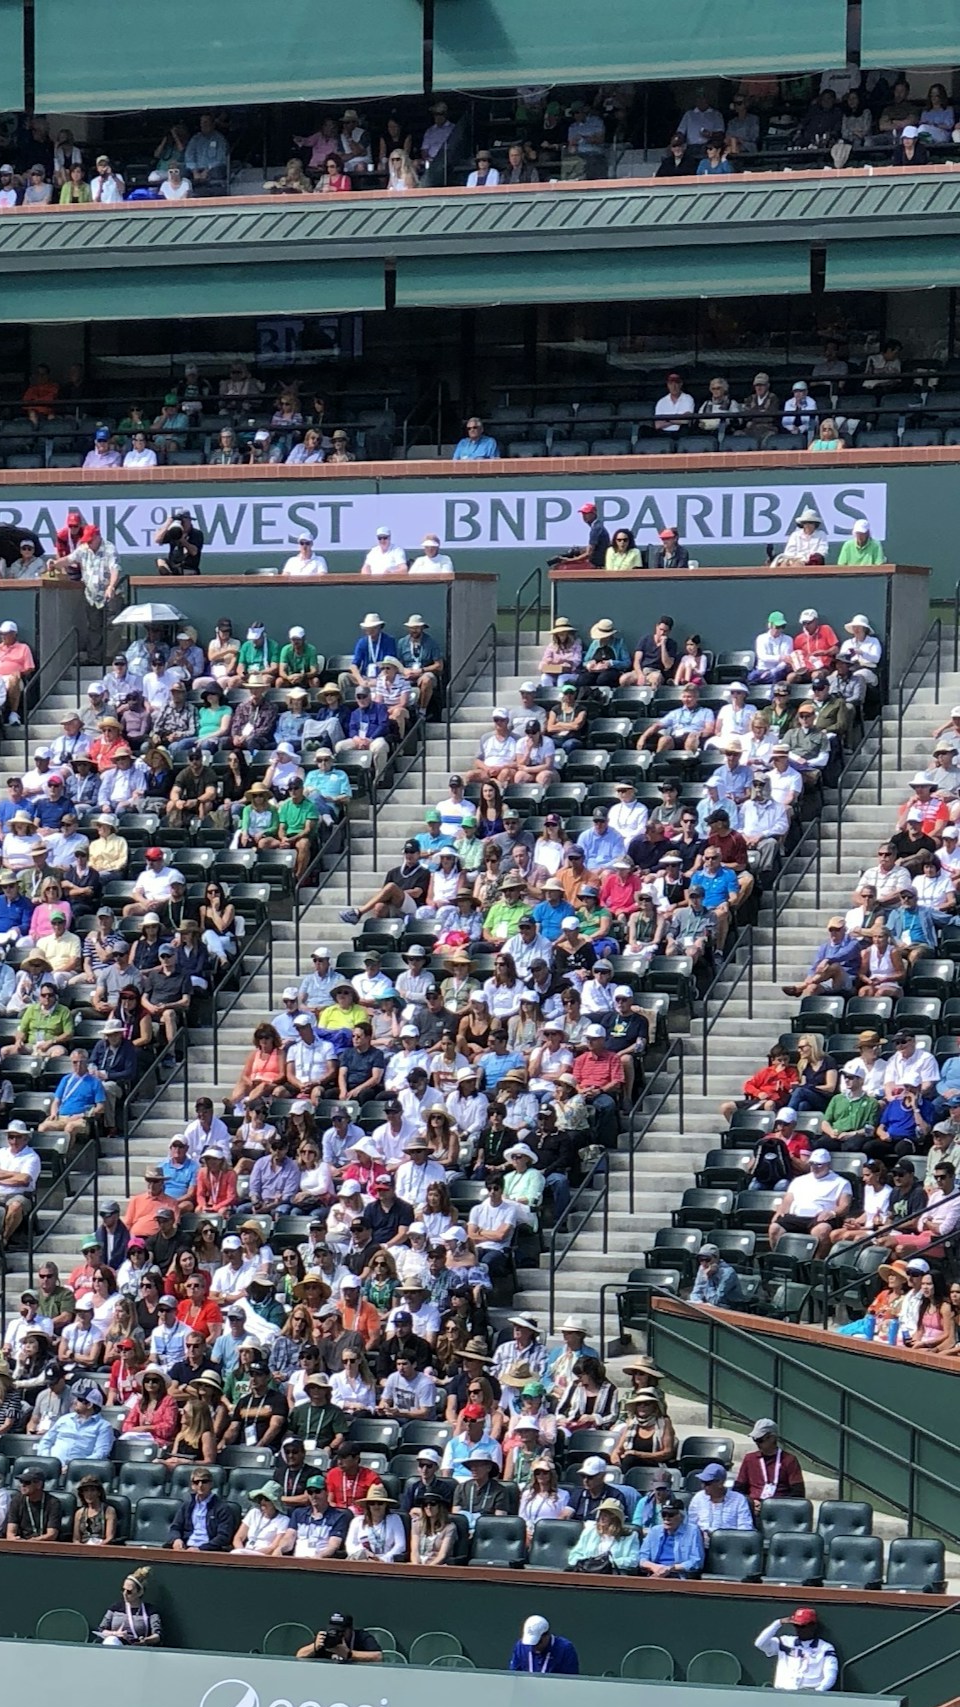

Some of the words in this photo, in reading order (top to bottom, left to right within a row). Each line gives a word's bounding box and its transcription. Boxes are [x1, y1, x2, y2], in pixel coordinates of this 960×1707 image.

[192, 500, 353, 546] WEST
[443, 497, 574, 542] BNP
[593, 489, 868, 539] PARIBAS
